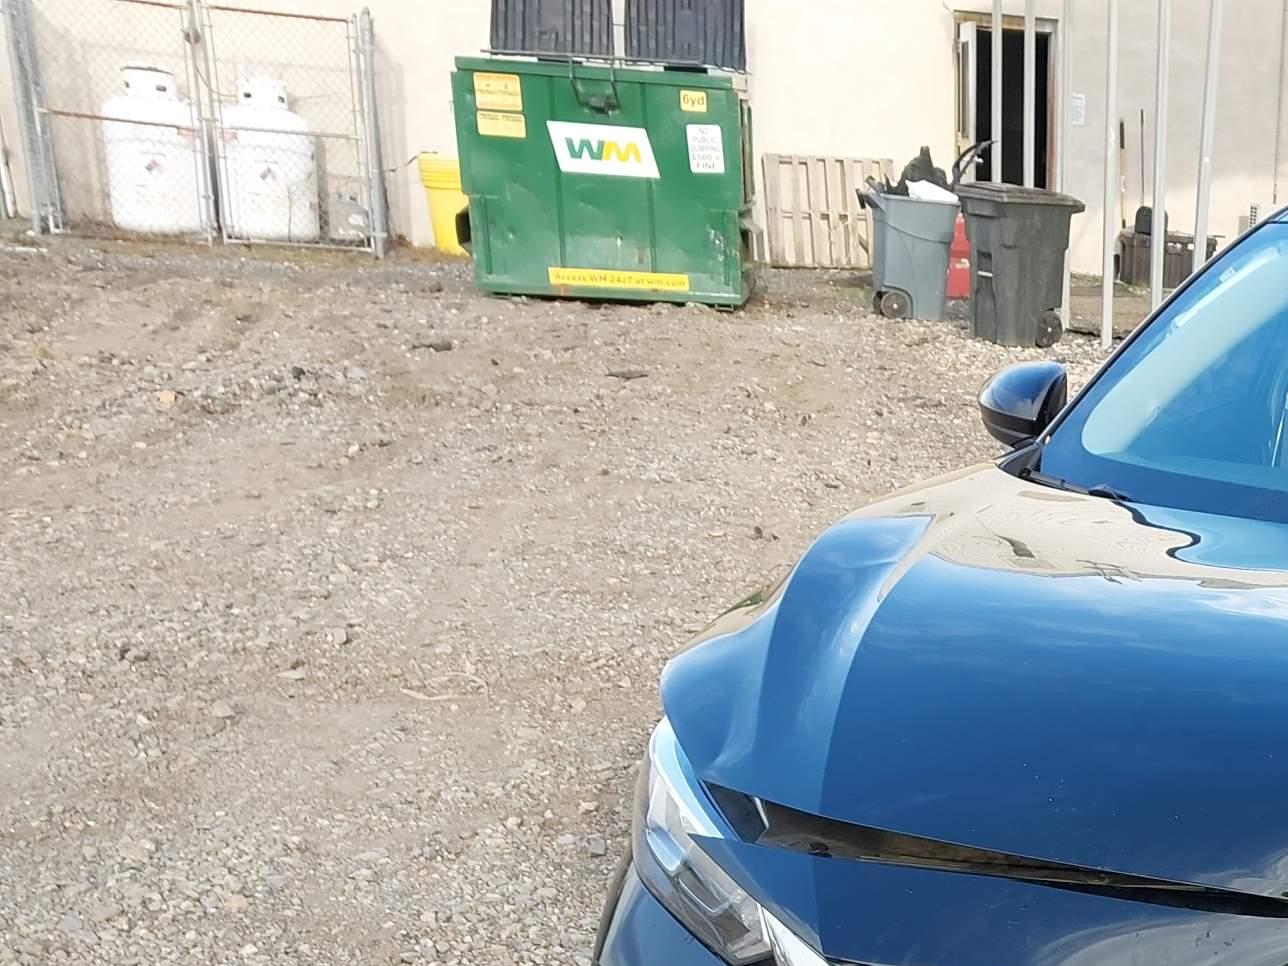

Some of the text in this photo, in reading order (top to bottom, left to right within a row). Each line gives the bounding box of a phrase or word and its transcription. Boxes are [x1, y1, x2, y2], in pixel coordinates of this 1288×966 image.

[682, 93, 705, 107] 6yd
[564, 136, 642, 164] WM
[554, 272, 587, 281] Access
[589, 274, 607, 282] WM
[647, 279, 686, 287] wm.com
